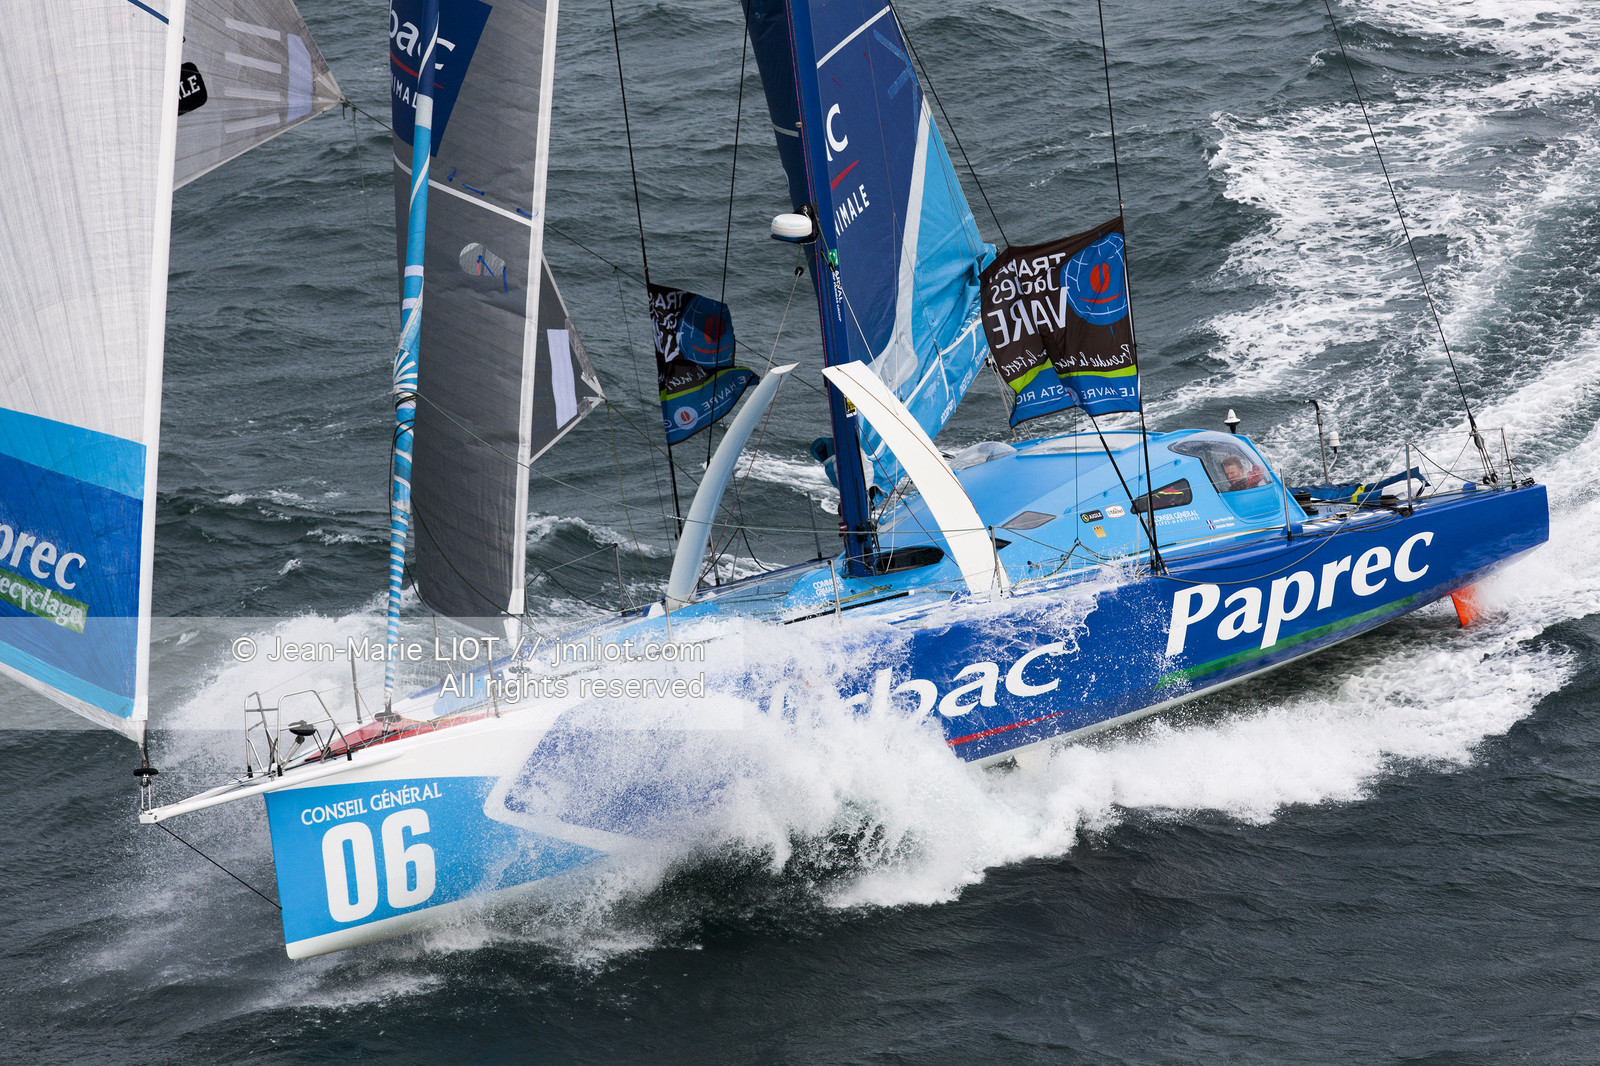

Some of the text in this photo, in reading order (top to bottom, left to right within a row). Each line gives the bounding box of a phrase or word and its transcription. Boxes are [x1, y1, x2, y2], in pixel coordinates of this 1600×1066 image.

[179, 75, 201, 100] LE
[1165, 531, 1434, 657] Paprec
[301, 782, 443, 826] CONSEIL GÉNÉRAL
[321, 808, 436, 923] 06
